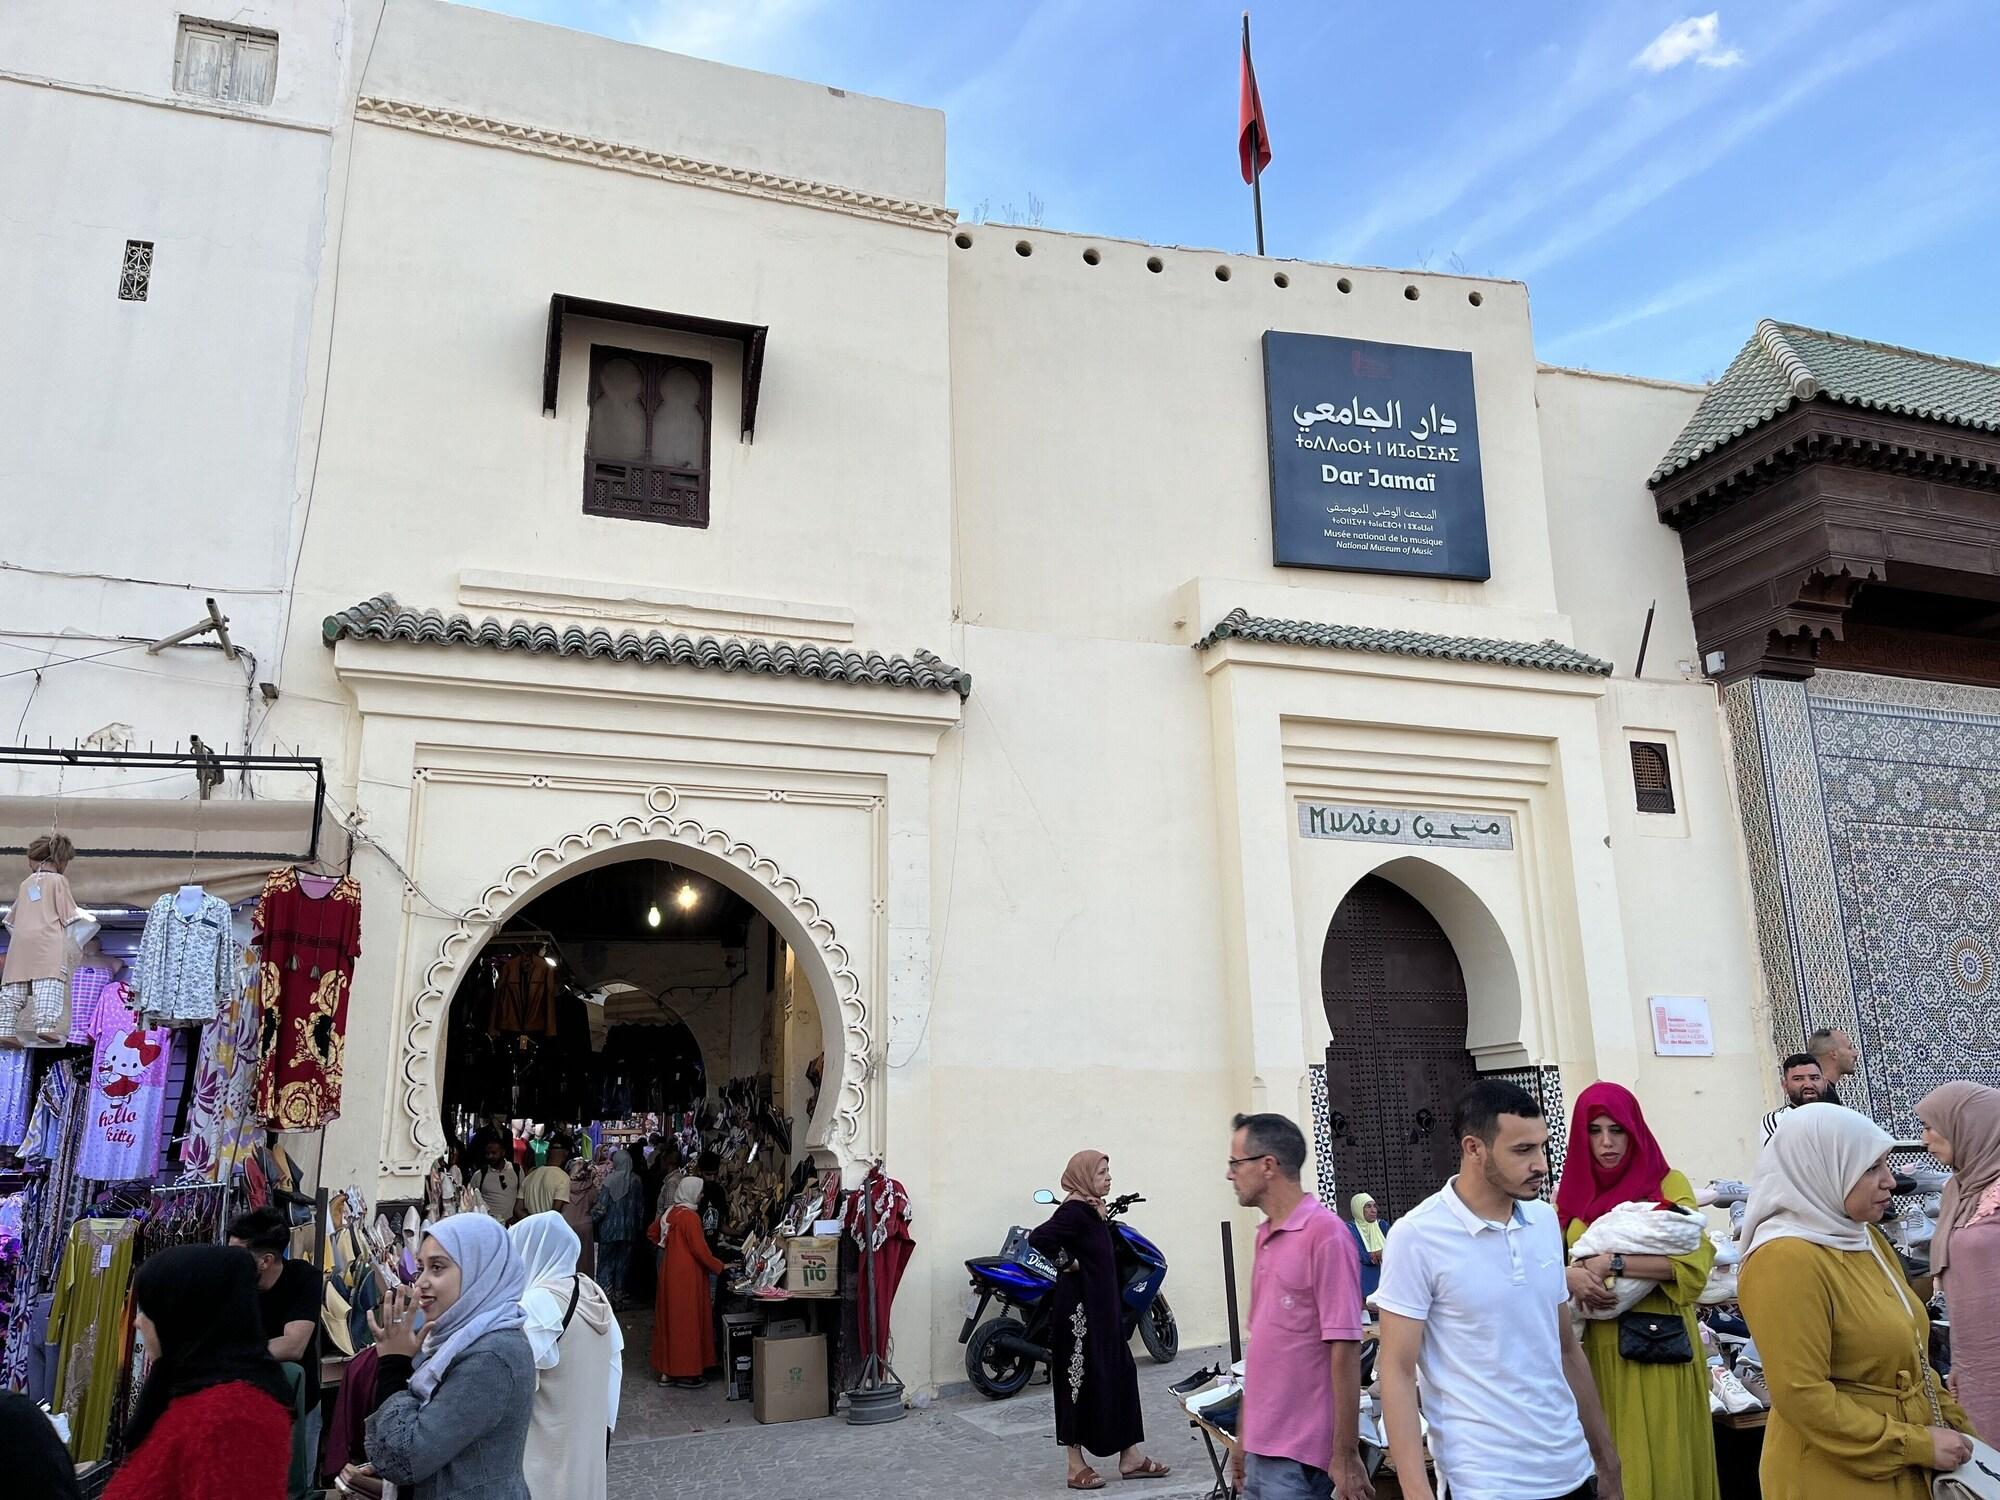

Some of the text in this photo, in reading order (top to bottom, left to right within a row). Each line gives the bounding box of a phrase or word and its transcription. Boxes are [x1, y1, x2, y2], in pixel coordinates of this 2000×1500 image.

[1293, 396, 1457, 440] دار الجامعي
[1321, 464, 1436, 491] Dar Jamaï
[1323, 529, 1444, 547] Musée national de la musique
[1336, 541, 1434, 556] National Museum of Music
[98, 1107, 137, 1128] hello
[106, 1127, 137, 1149] kitty
